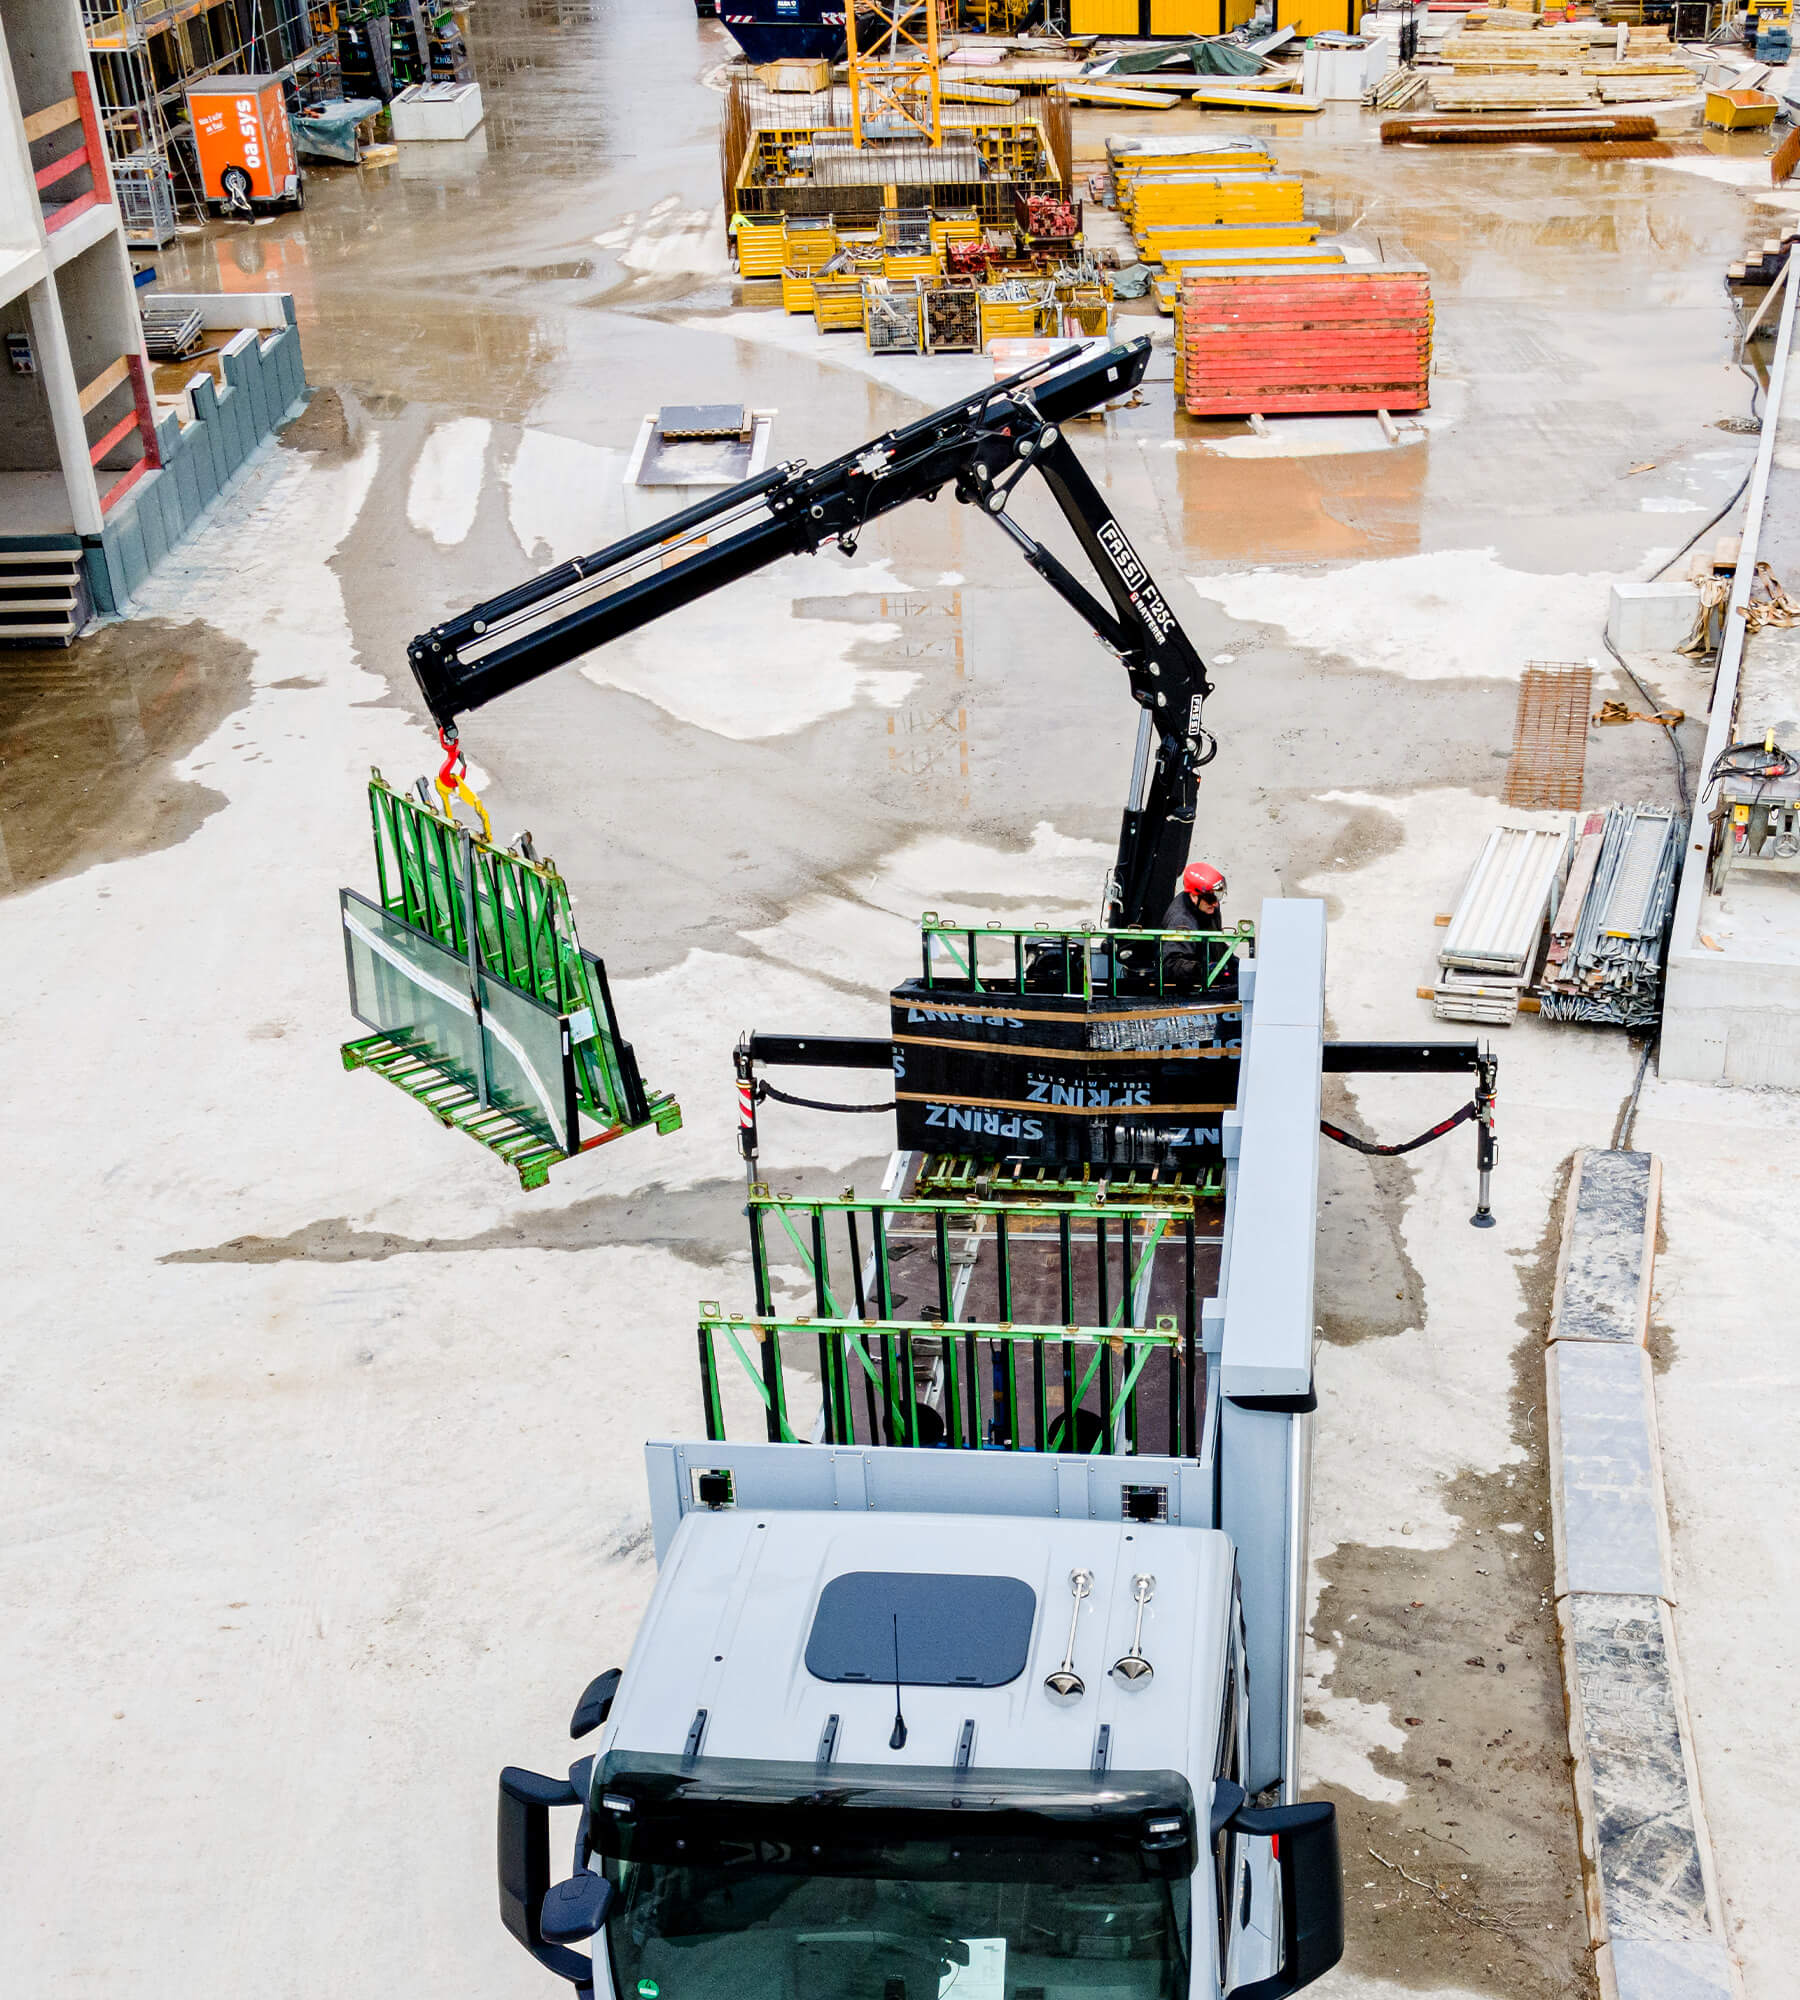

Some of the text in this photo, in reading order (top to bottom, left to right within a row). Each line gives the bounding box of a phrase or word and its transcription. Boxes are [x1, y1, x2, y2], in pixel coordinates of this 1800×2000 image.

[236, 99, 261, 168] oa.sys
[1102, 528, 1176, 633] FASSI F125C
[1135, 599, 1166, 646] NATTERER
[1190, 697, 1201, 733] FASSI
[1025, 1079, 1152, 1108] SPRINZ
[924, 1103, 1044, 1140] SPRINZ
